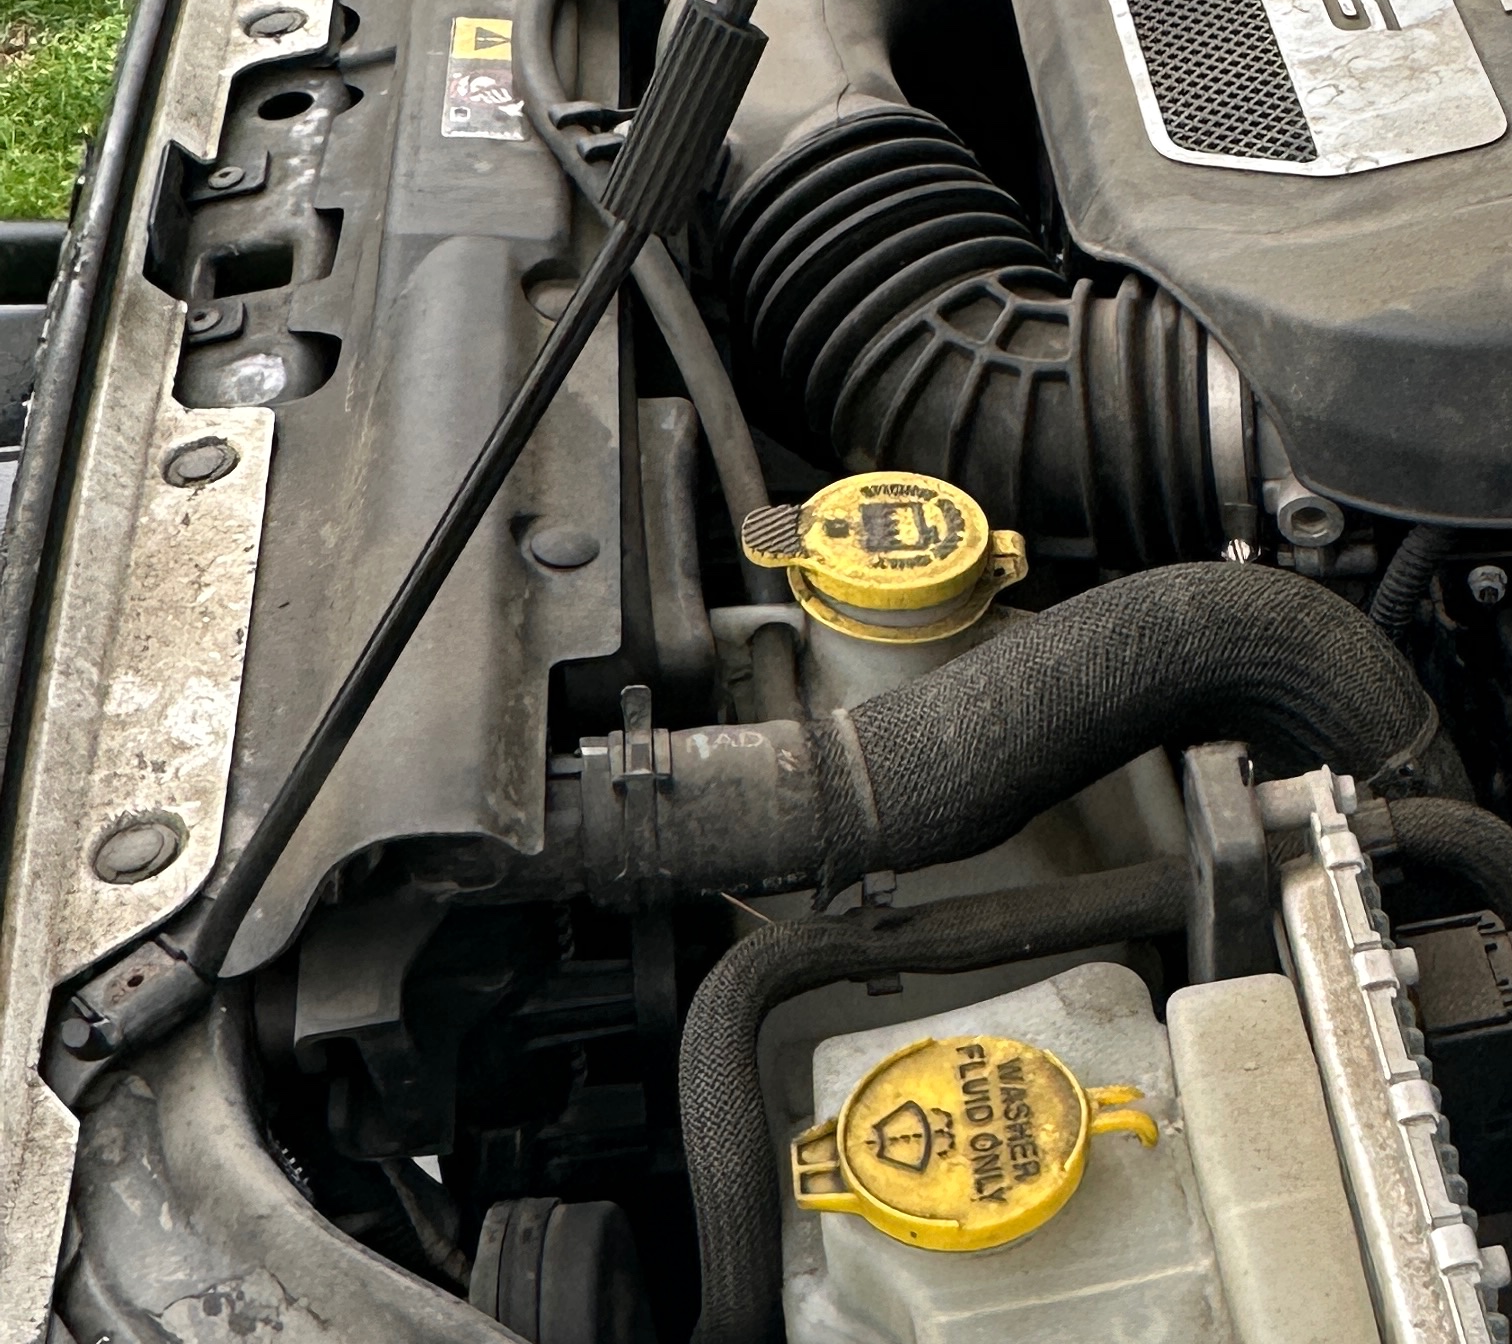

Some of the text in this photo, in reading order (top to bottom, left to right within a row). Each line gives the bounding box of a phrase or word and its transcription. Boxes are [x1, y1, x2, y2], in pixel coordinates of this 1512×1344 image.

[955, 1043, 1013, 1205] FLUID ONLY
[997, 1055, 1041, 1181] WASHER
